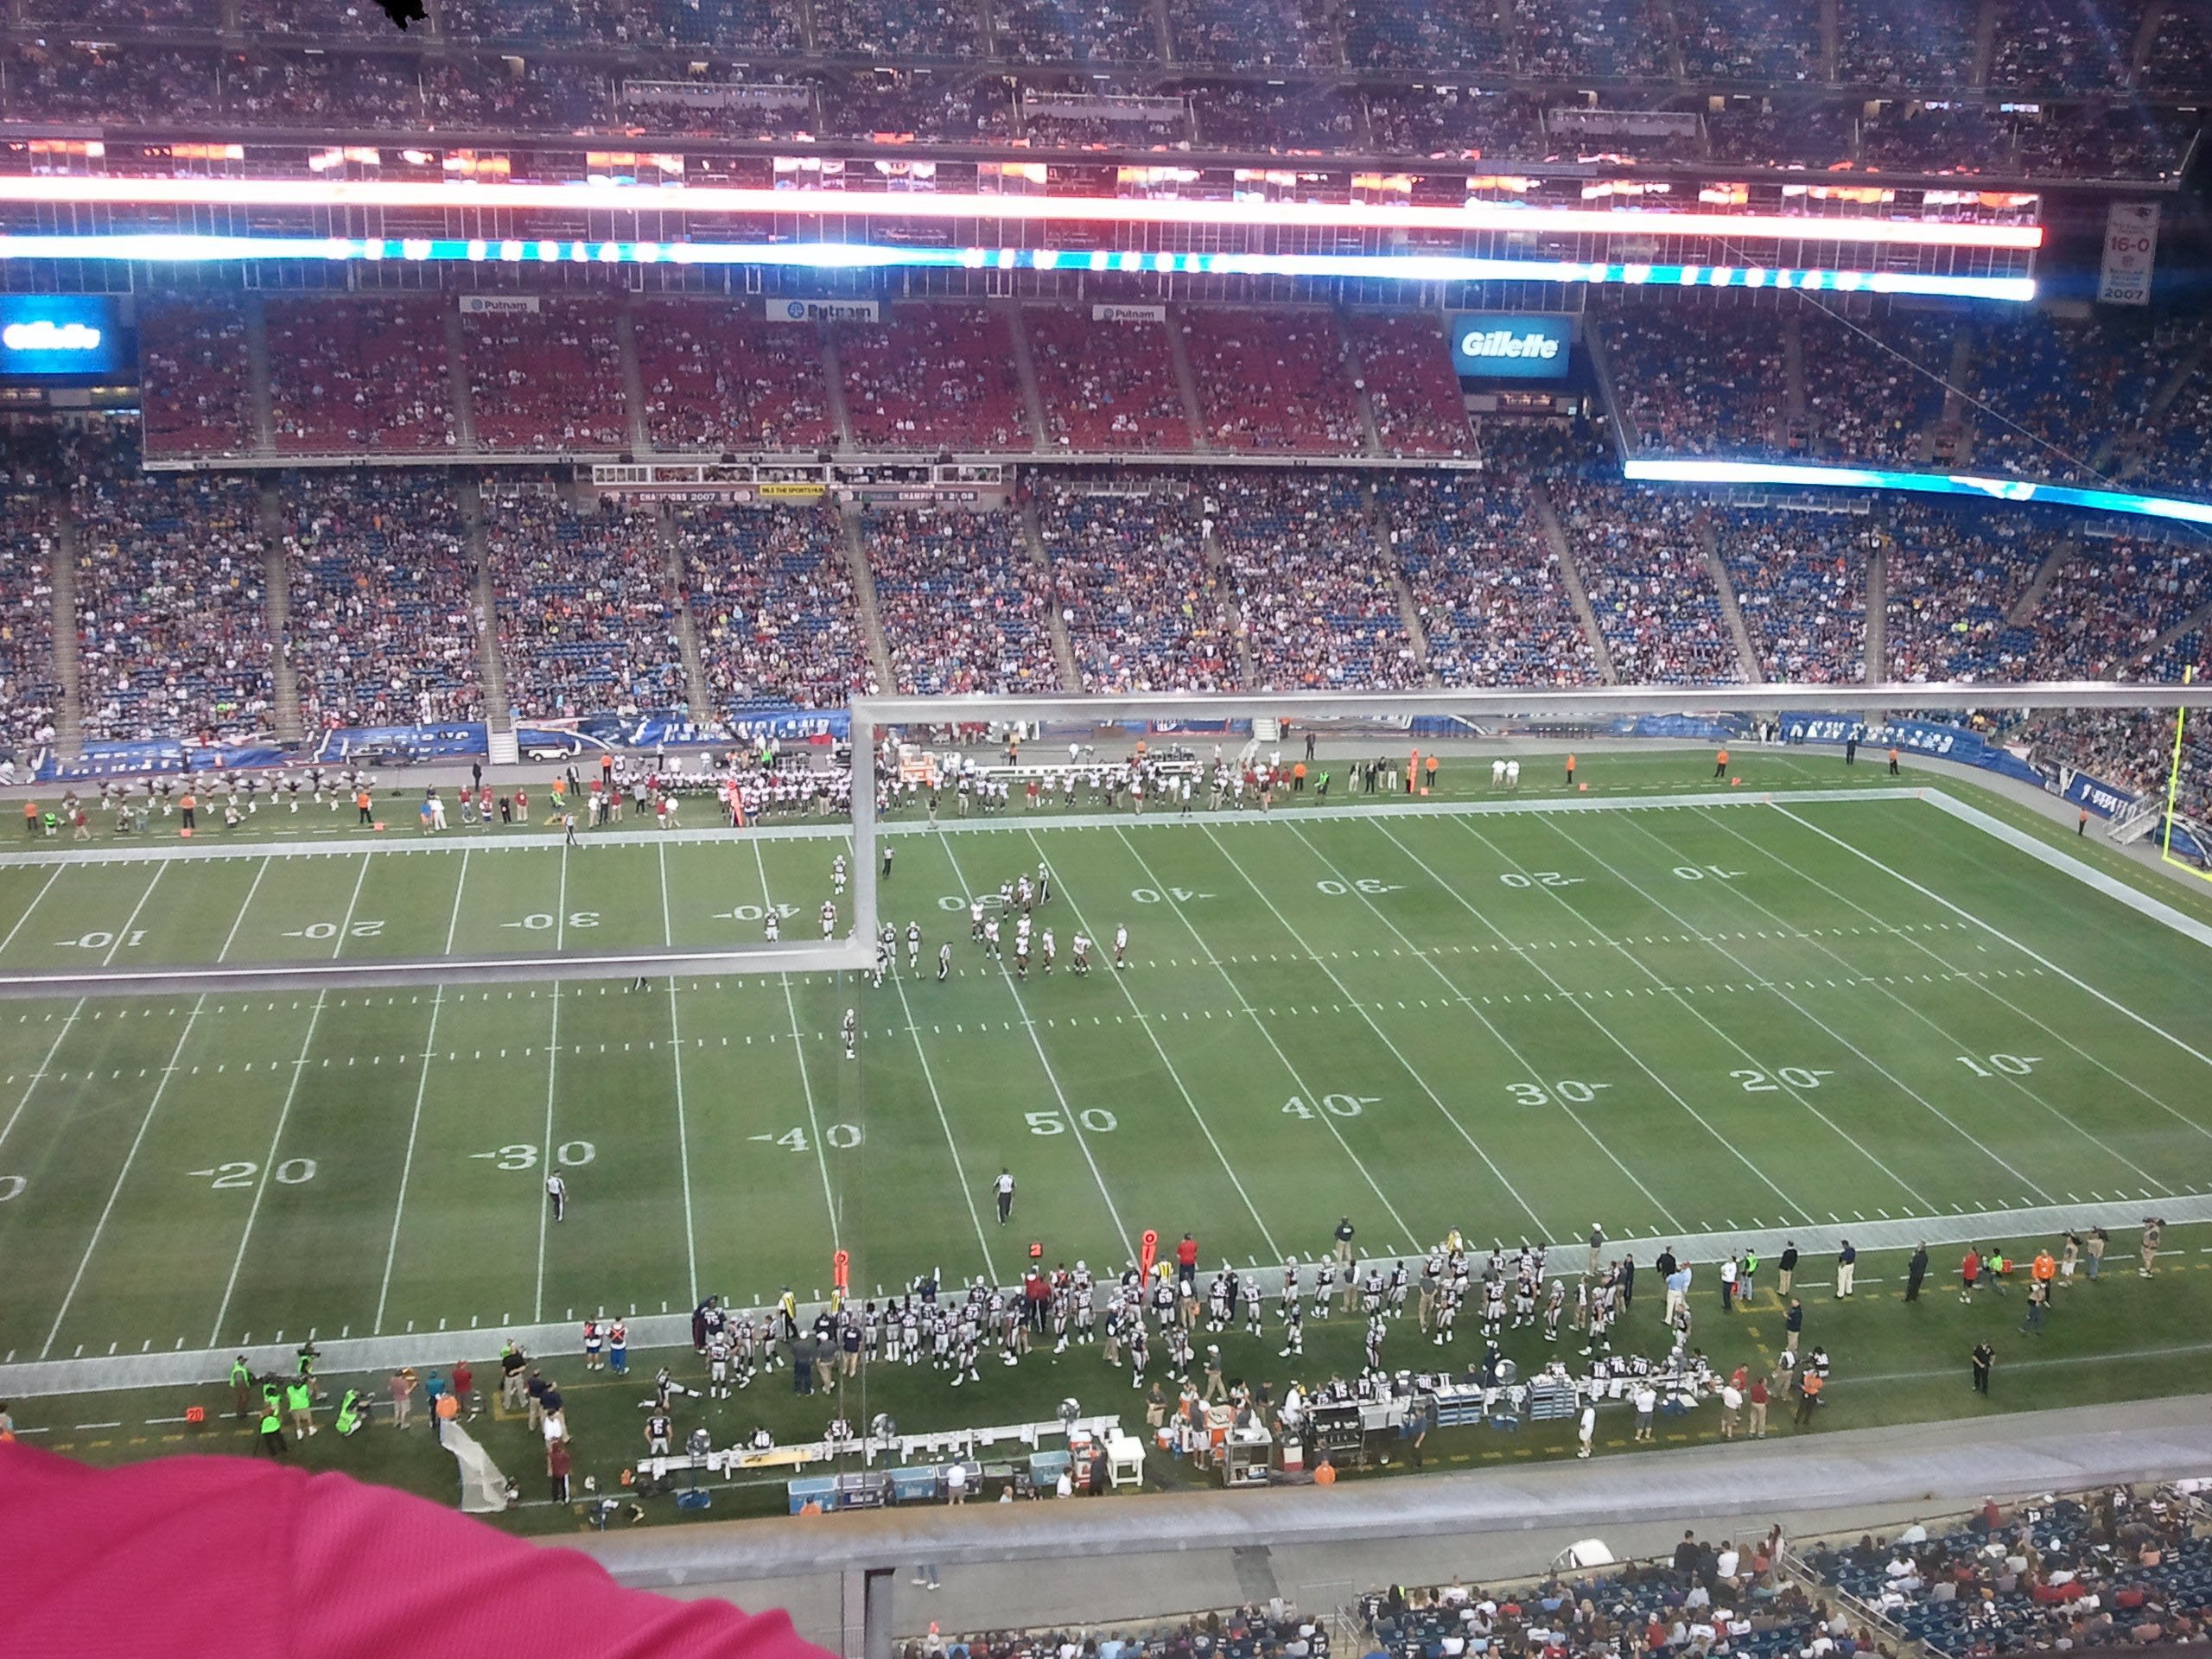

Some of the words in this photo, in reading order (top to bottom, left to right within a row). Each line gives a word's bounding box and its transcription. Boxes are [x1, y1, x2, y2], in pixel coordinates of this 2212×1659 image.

[2113, 237, 2150, 251] 16-0
[2105, 289, 2143, 300] 2007
[808, 304, 871, 319] Putnam
[1116, 309, 1154, 319] Putnam
[1462, 330, 1559, 359] Gillette
[690, 493, 716, 501] 2007
[1500, 872, 1569, 888] 20
[1673, 865, 1734, 880] 10
[1317, 878, 1388, 895] 30
[1131, 887, 1194, 904] 40
[734, 904, 800, 920] 40
[524, 912, 600, 930] 30
[304, 920, 385, 939] 20
[79, 930, 149, 949] 10
[1955, 1054, 2032, 1077] 10
[1730, 1067, 1820, 1091] 20
[1506, 1080, 1595, 1107] 30
[1281, 1094, 1363, 1119] 40
[1024, 1109, 1118, 1135] 50
[777, 1123, 865, 1152] 40
[497, 1141, 596, 1170] 30
[212, 1158, 317, 1189] 20
[1031, 1244, 1042, 1256] 2
[1159, 1293, 1173, 1303] 69
[1611, 1361, 1624, 1373] 76
[1634, 1361, 1647, 1374] 70
[1336, 1384, 1348, 1398] 15
[1359, 1382, 1370, 1395] 17
[654, 1424, 662, 1434] 6
